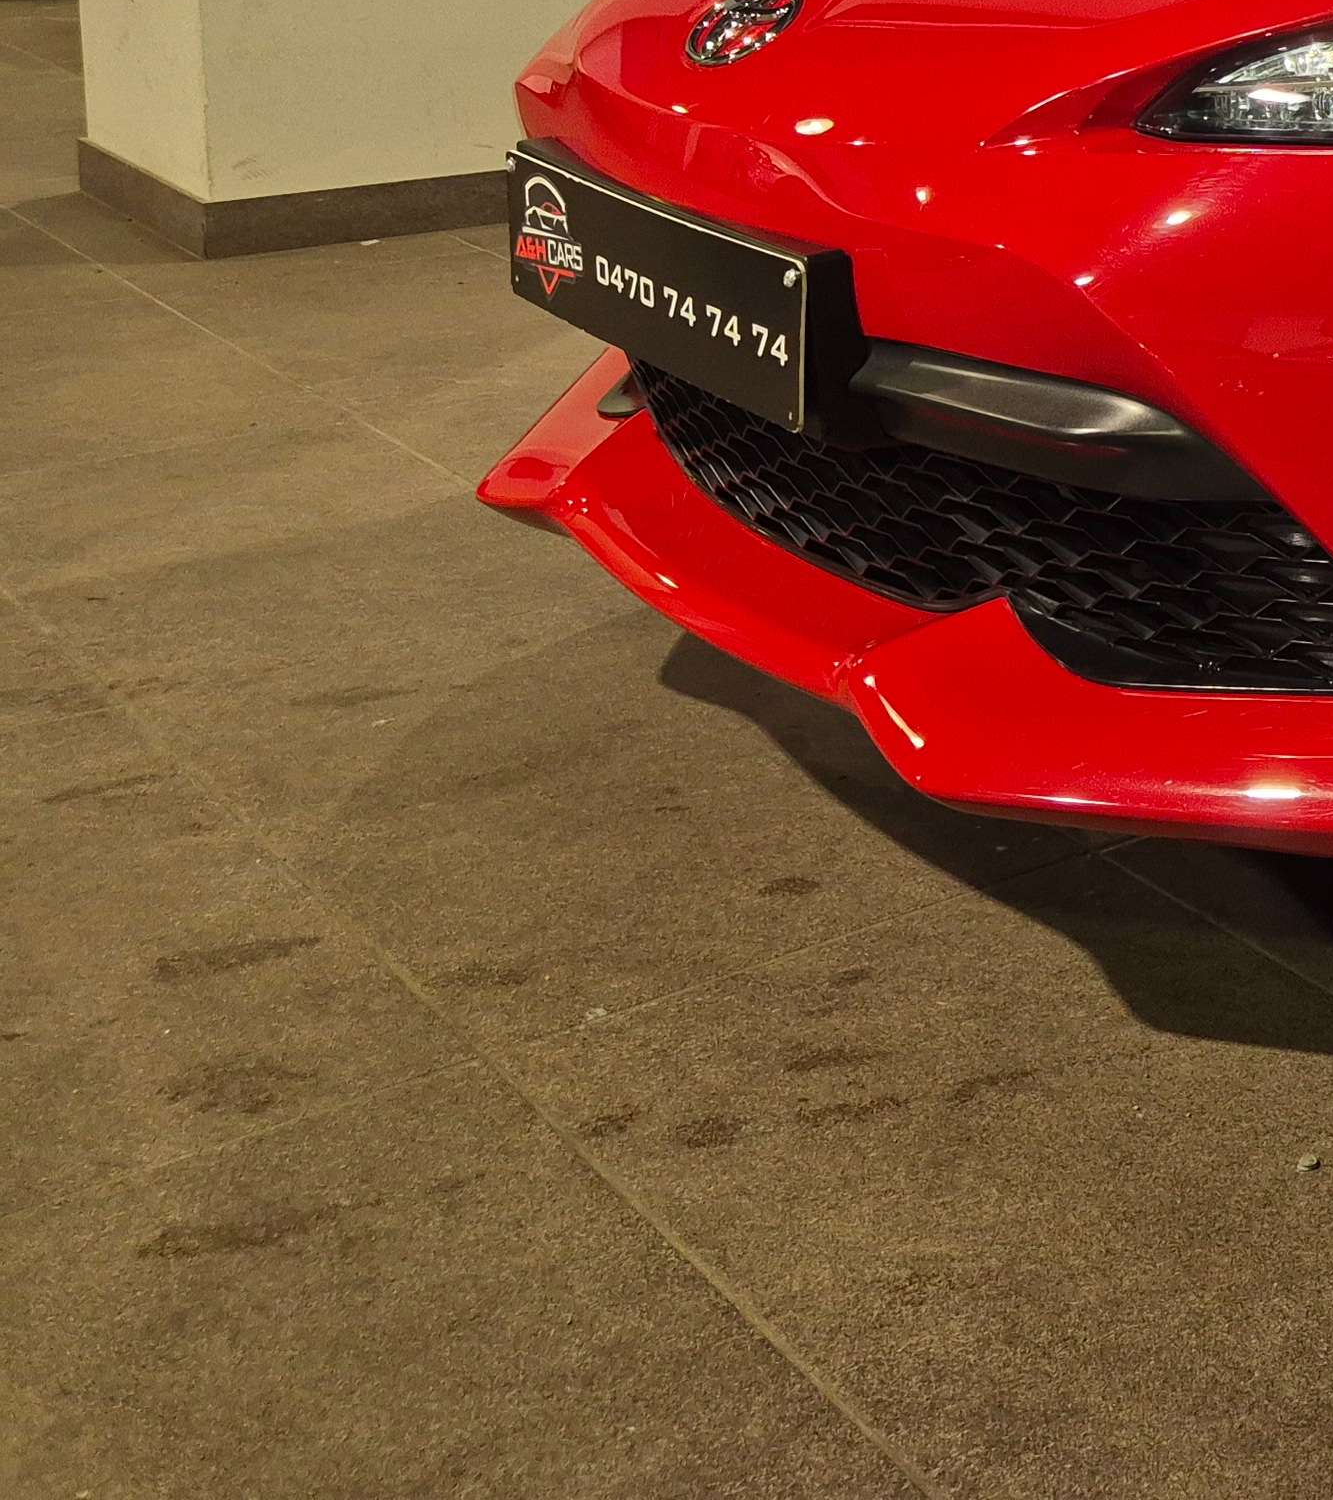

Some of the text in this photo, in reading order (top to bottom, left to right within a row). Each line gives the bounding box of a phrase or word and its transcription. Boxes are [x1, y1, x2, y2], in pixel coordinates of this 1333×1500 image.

[595, 255, 789, 367] 0470 74 74 74
